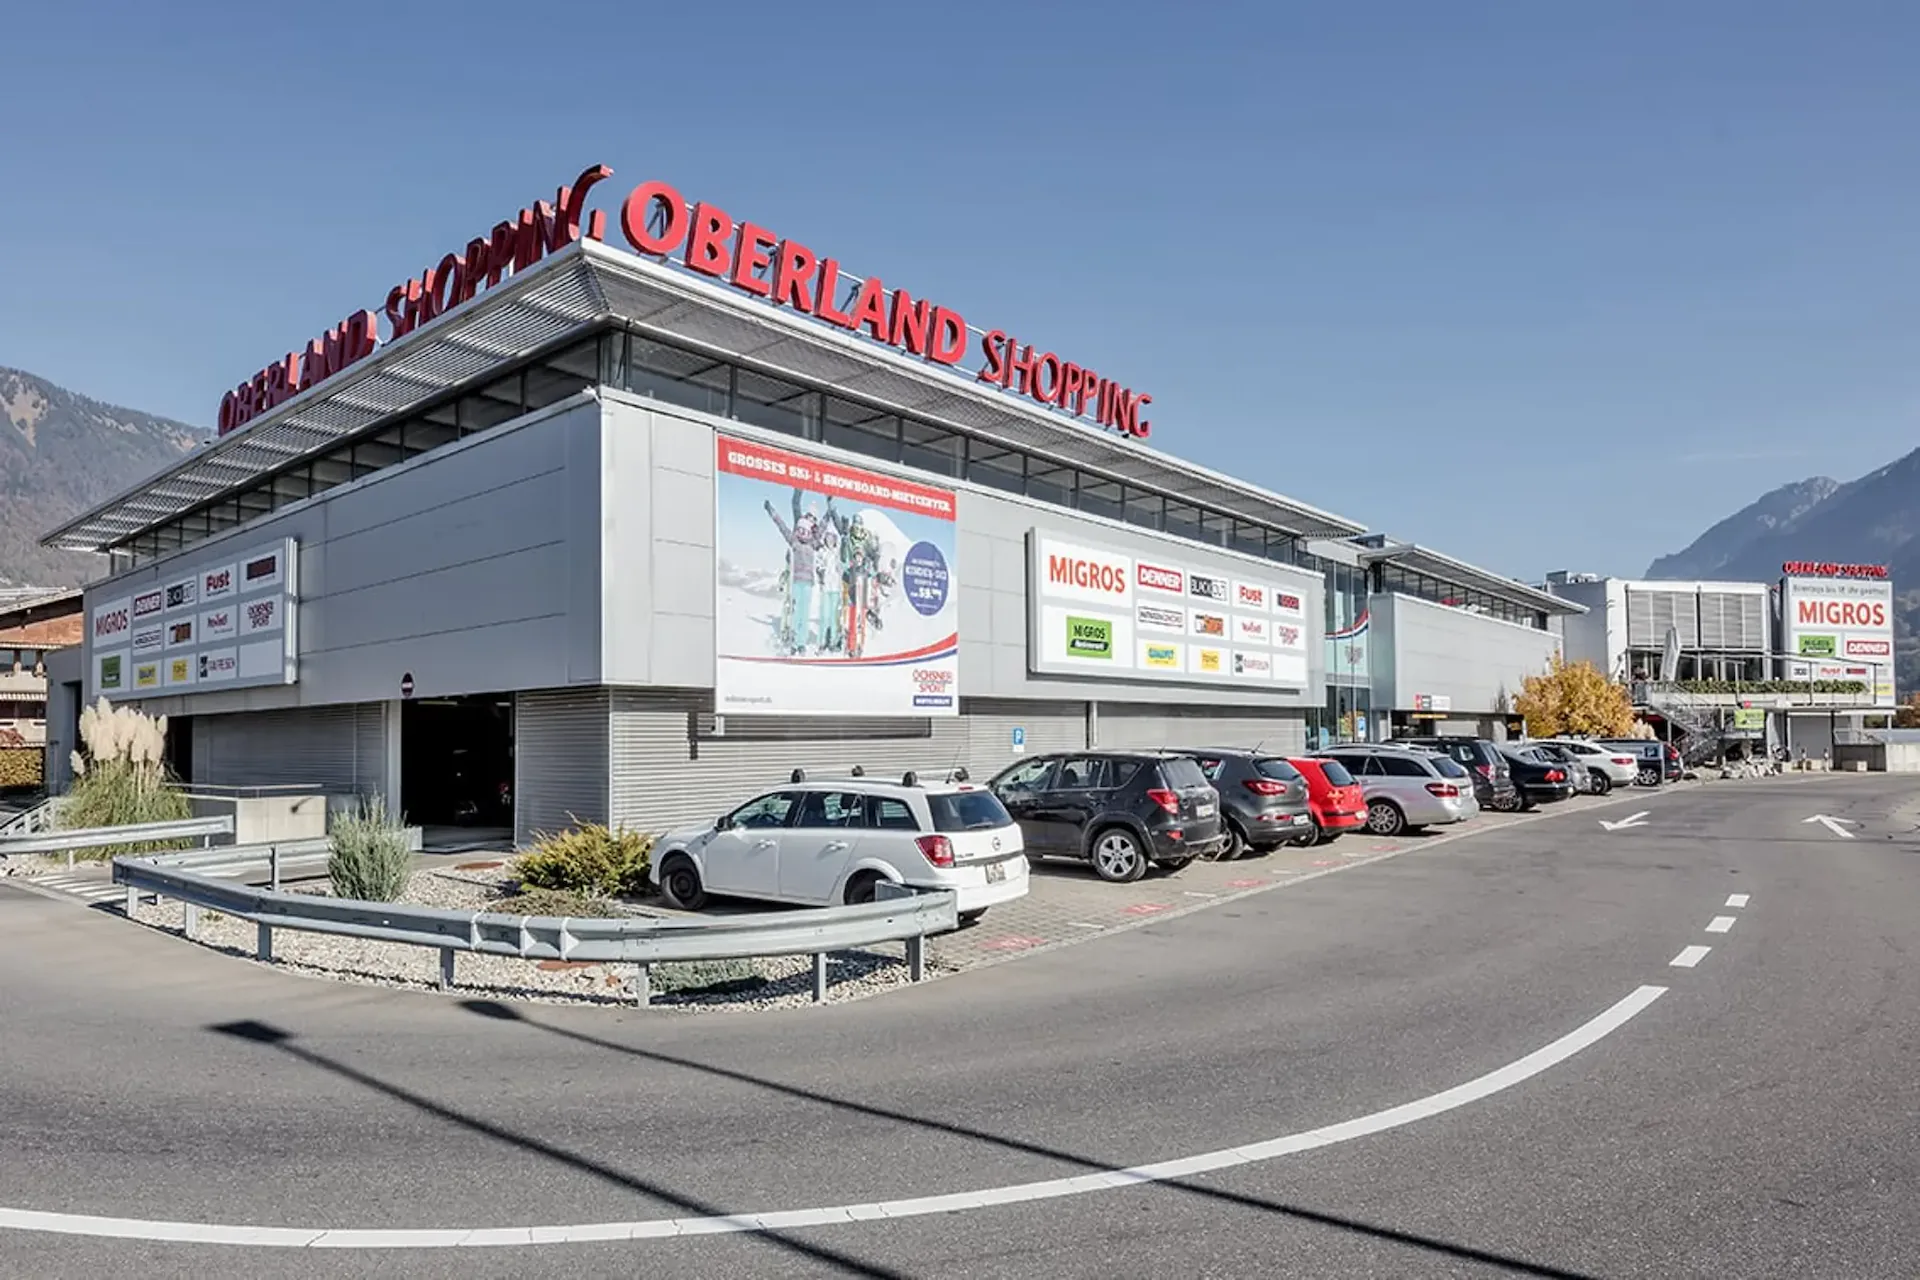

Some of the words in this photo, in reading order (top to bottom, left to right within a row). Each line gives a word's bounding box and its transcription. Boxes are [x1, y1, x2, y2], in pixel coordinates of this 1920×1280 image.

[218, 309, 378, 437] OBERLAND
[385, 164, 614, 342] SHOPPING
[621, 180, 966, 365] OBERLAND
[977, 330, 1152, 438] SHOPPING
[728, 452, 786, 475] GROSSES
[1049, 555, 1125, 593] MIGROS
[1141, 567, 1180, 590] DENNER
[96, 609, 128, 637] MIGROS
[1798, 601, 1885, 626] MIGROS
[1074, 625, 1105, 639] MIGROS
